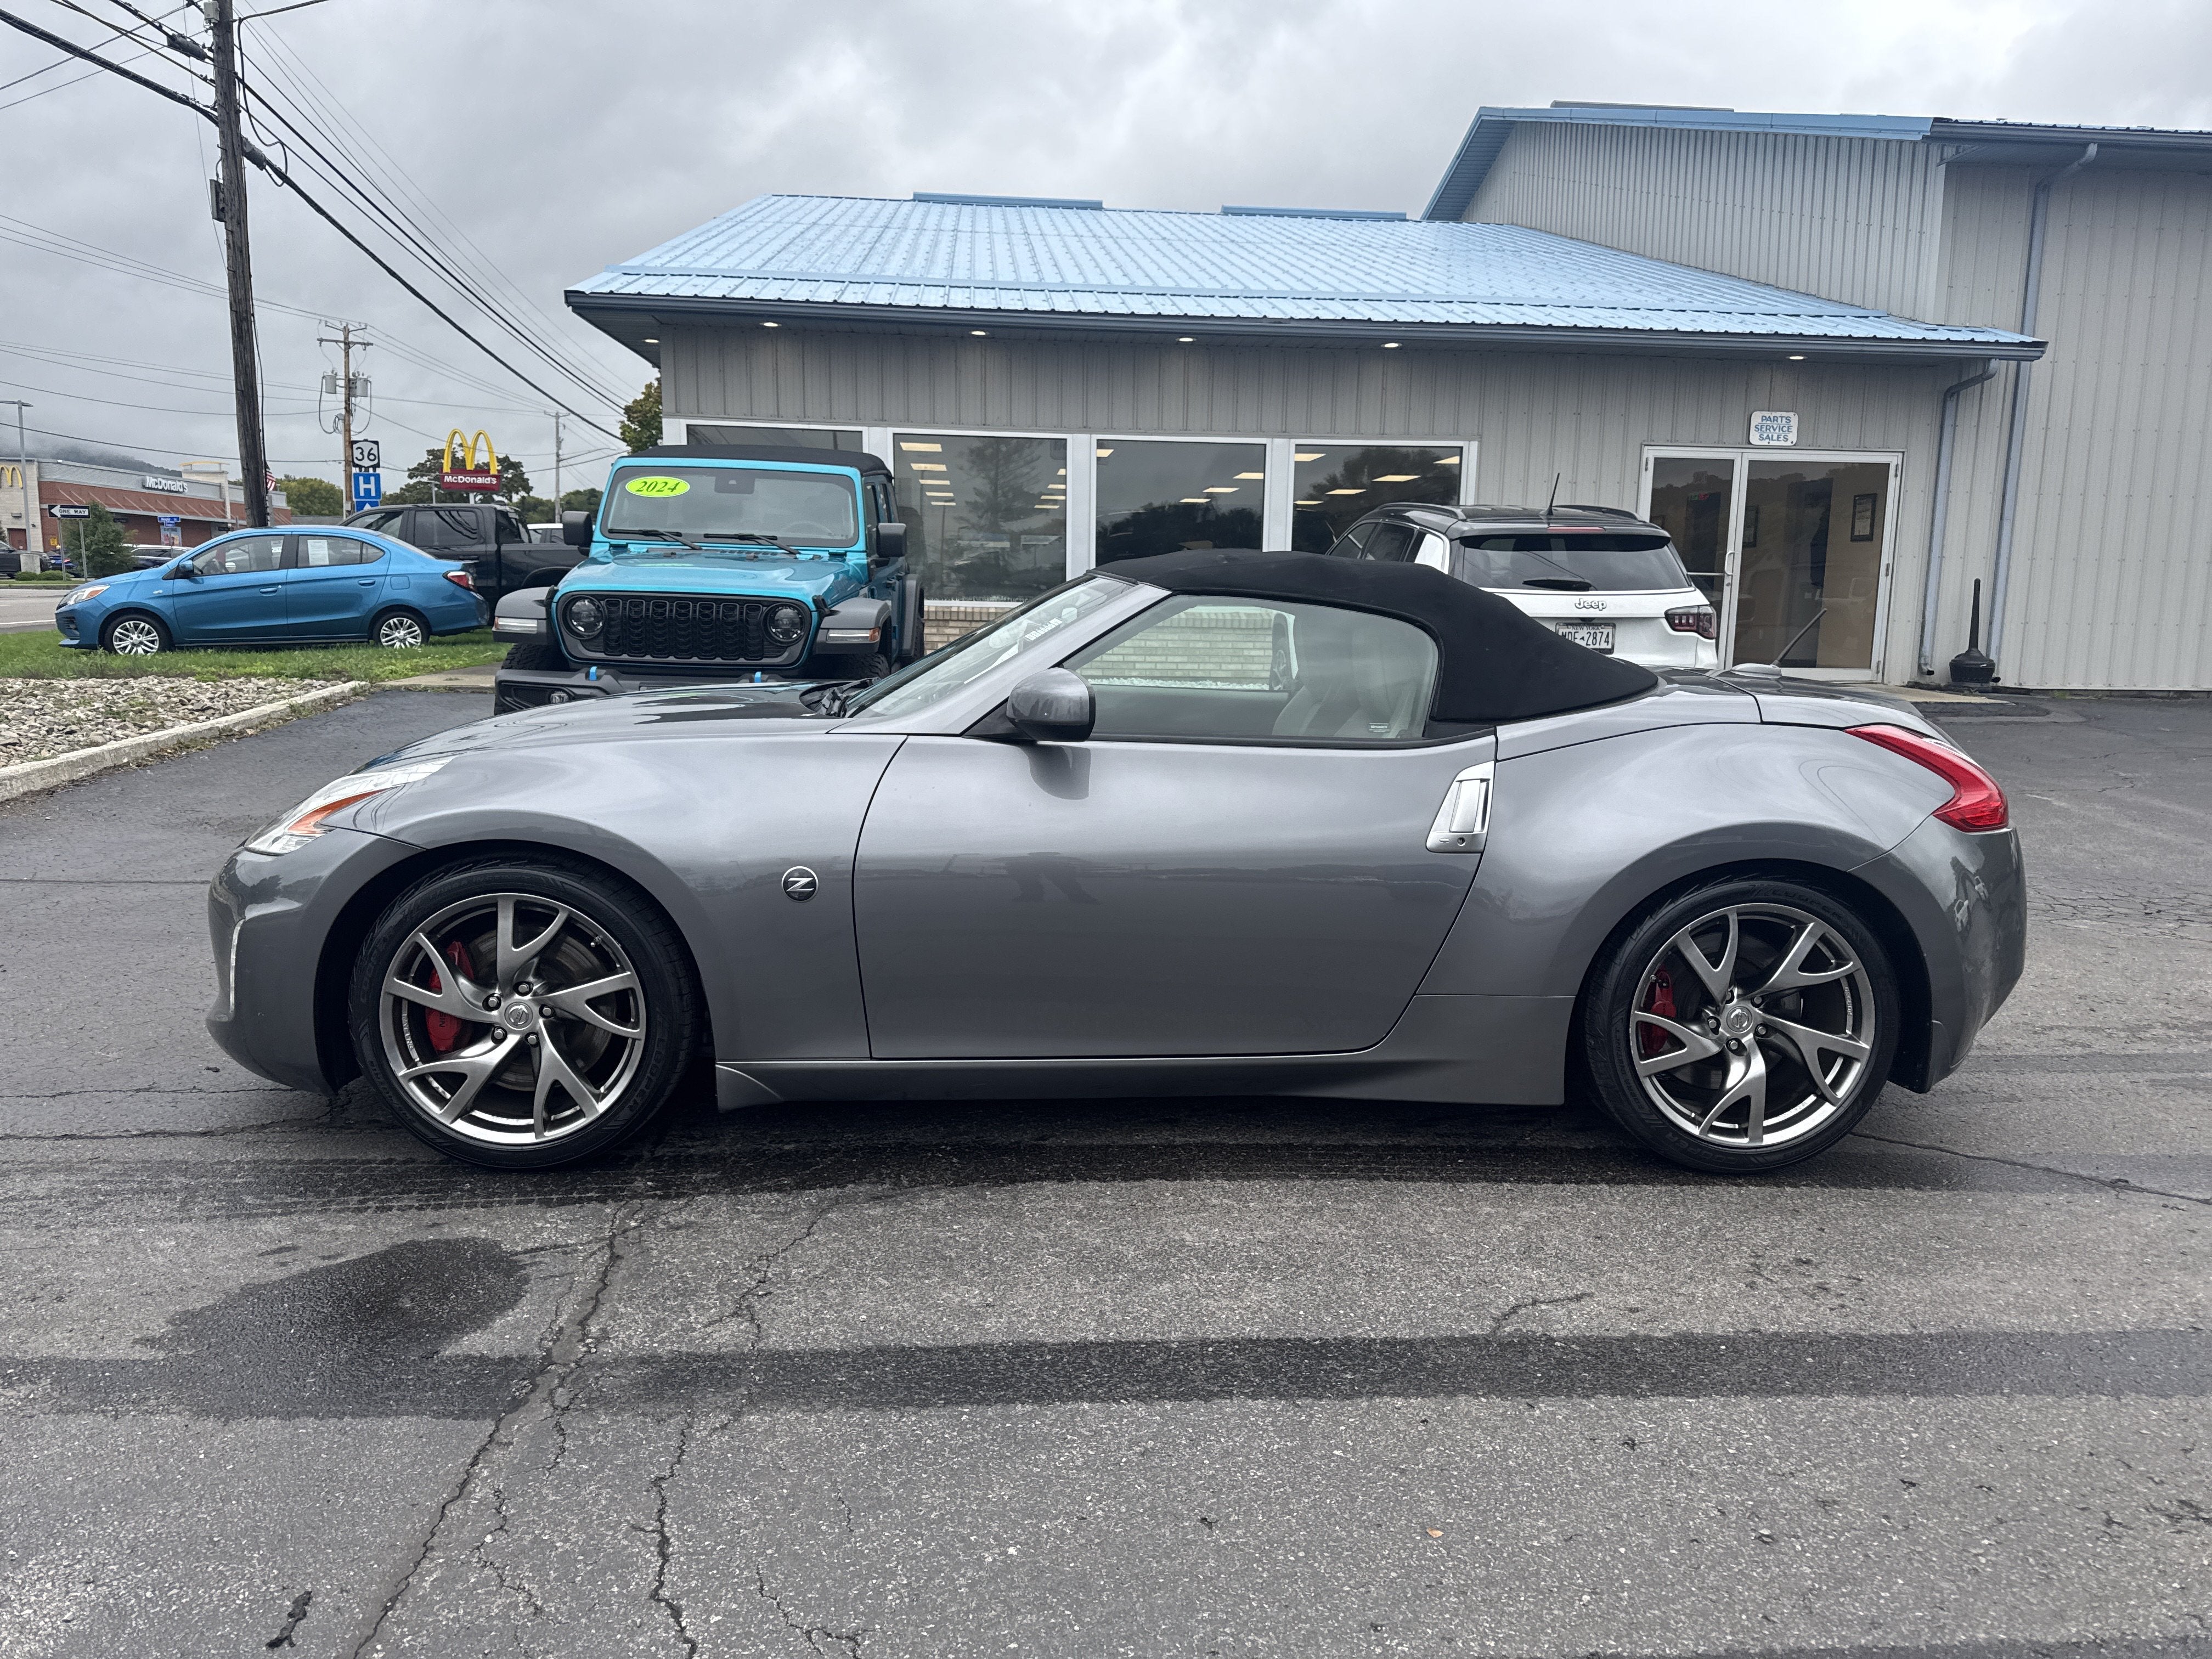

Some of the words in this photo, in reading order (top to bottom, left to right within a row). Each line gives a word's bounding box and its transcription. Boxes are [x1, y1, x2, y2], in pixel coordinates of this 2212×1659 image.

[1761, 415, 1791, 424] PARTS
[355, 447, 377, 461] 36
[146, 476, 188, 492] McDonald's
[359, 476, 376, 496] H
[444, 476, 497, 484] McDonald's
[635, 481, 680, 492] 2024
[1575, 598, 1607, 611] Jeep
[1585, 631, 1610, 646] 2874
[628, 1037, 668, 1113] COOPER
[1665, 1132, 1738, 1165] COOPER
